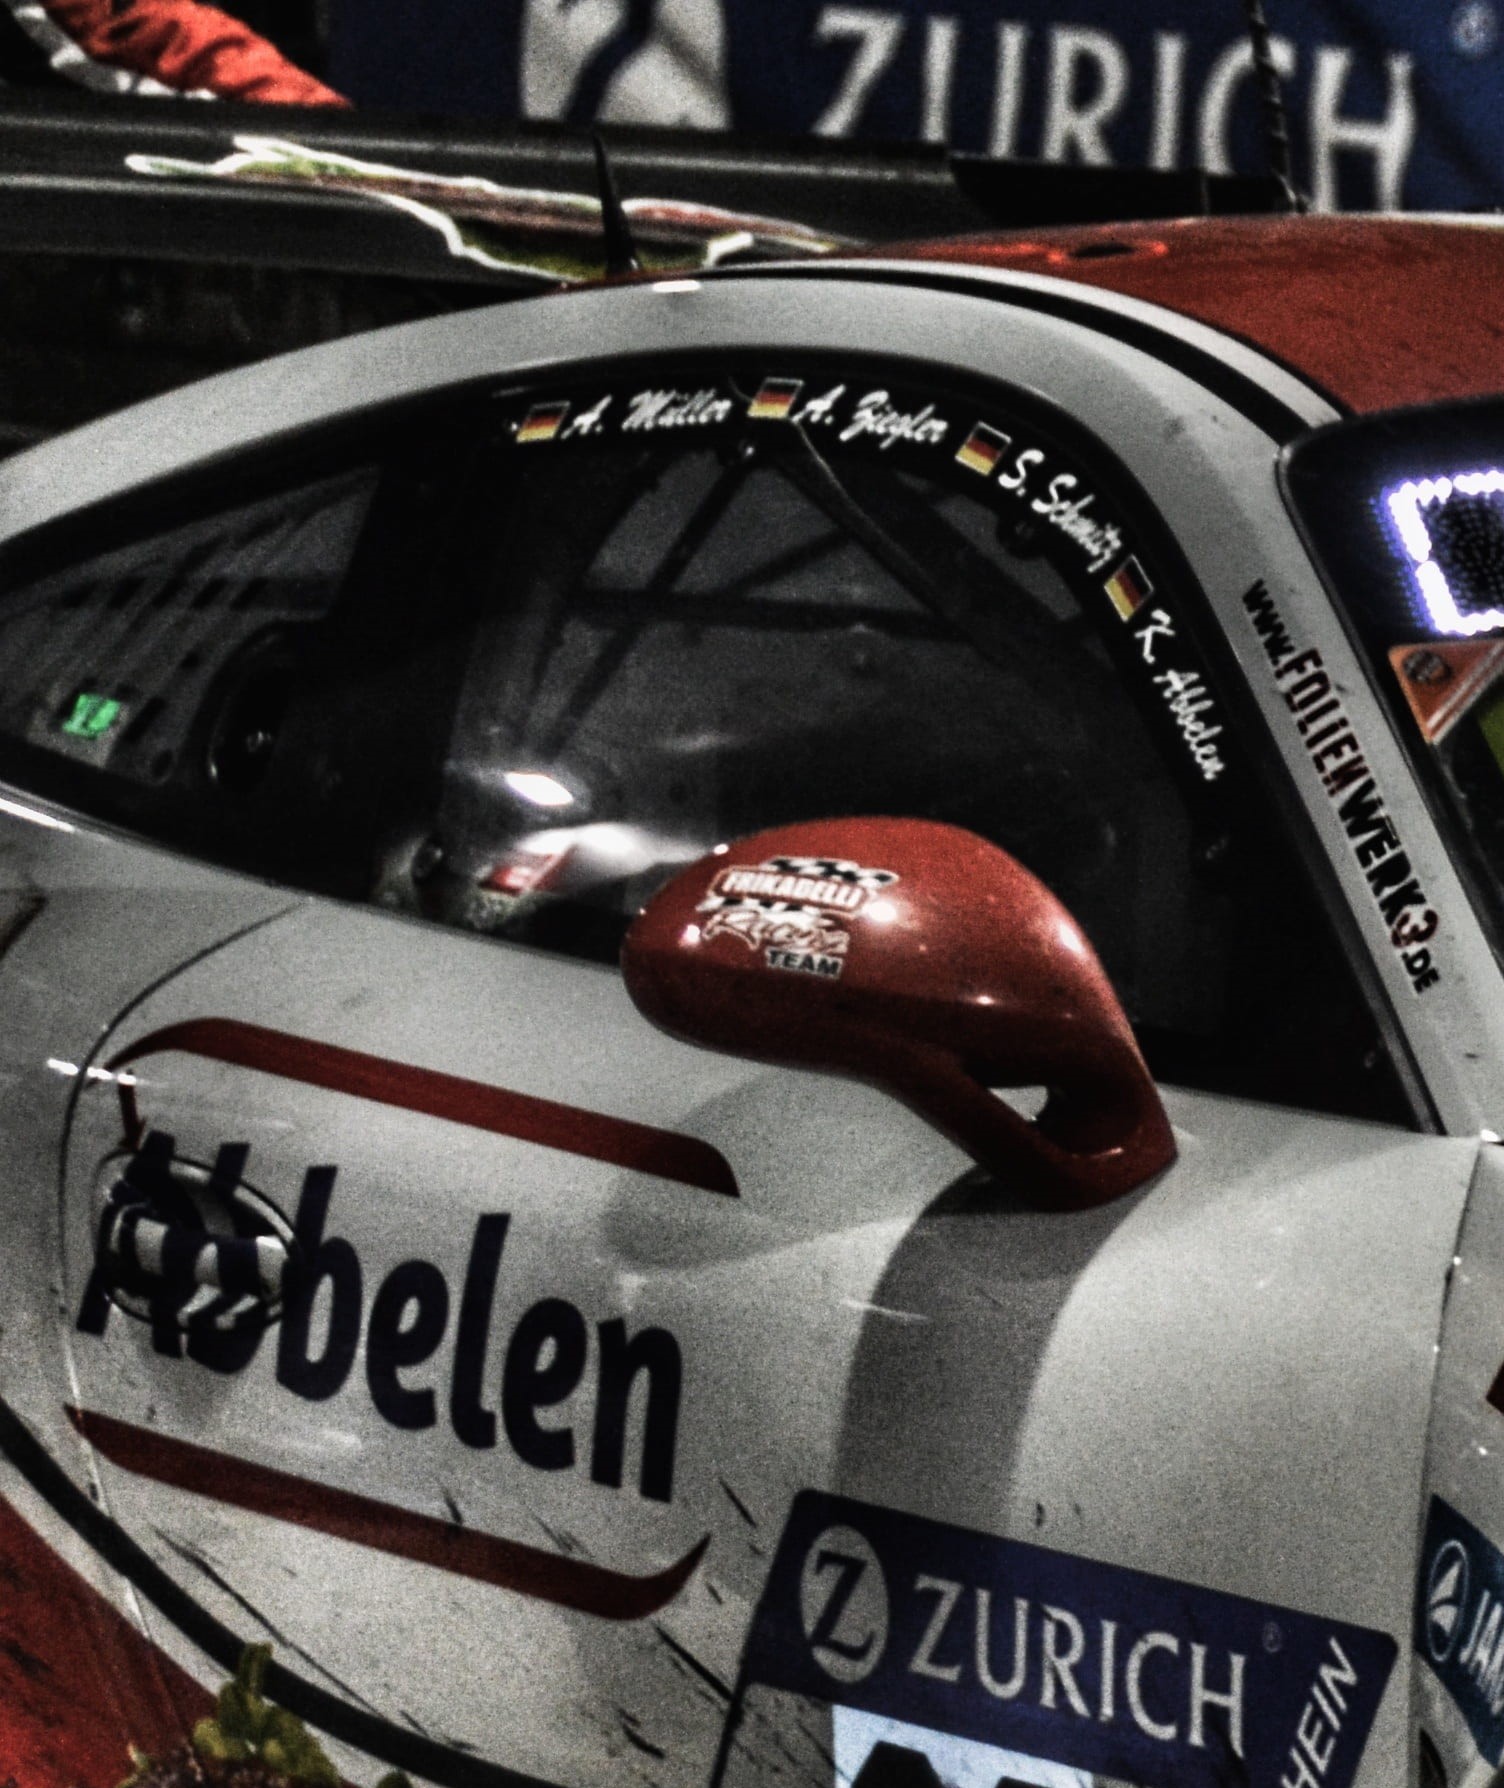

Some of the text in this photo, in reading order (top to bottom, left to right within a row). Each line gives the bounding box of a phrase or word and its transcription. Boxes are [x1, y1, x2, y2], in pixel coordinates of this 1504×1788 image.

[808, 5, 1416, 213] ZURICH
[621, 387, 732, 431] Müller
[838, 389, 948, 450] Ziegler
[997, 448, 1045, 498] S.
[766, 948, 842, 977] TEAM
[73, 1128, 684, 1504] Abbelen
[908, 1572, 1248, 1760] ZURICH
